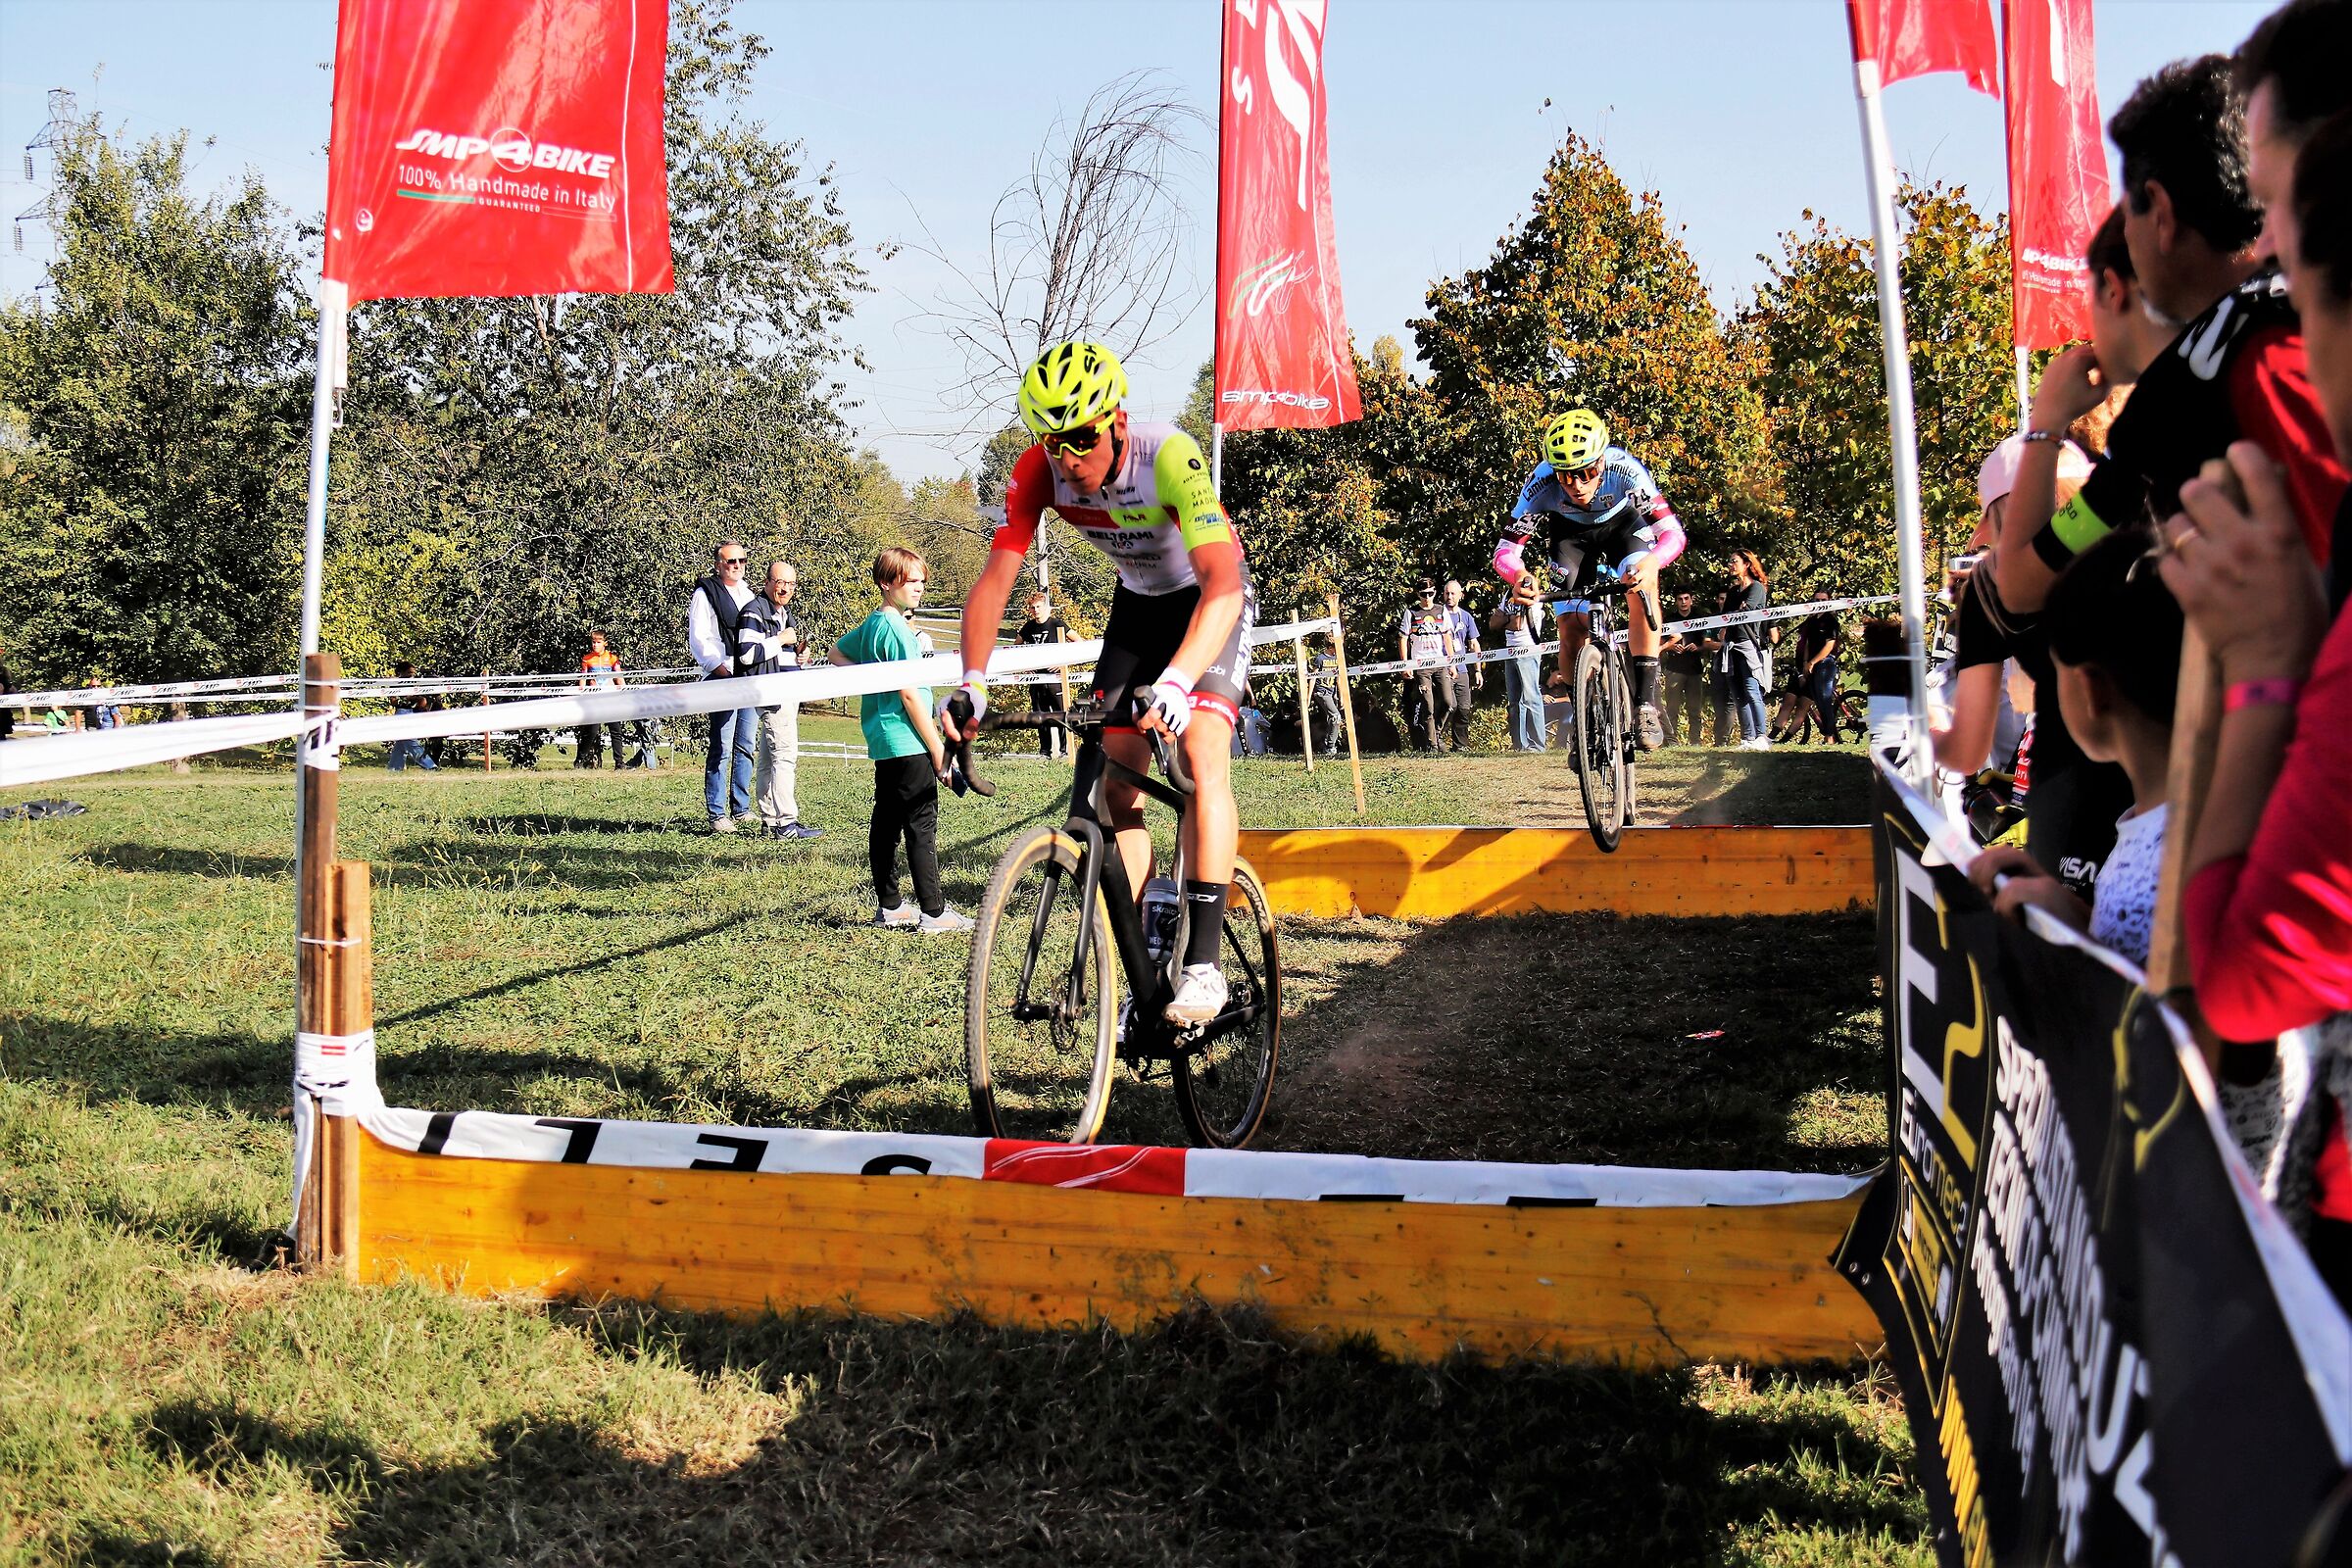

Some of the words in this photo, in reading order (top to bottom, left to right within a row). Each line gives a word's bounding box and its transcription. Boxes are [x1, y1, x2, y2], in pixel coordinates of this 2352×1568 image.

[395, 127, 615, 179] SMP4BIKE
[398, 165, 442, 190] 100%
[450, 172, 549, 202] Handmade
[554, 184, 570, 205] in
[575, 190, 617, 214] Italy
[478, 196, 541, 214] GUARANTEED
[1628, 488, 1650, 509] 24
[1087, 530, 1154, 541] BELTRAMI
[1728, 614, 1748, 624] SMP
[1689, 620, 1709, 630] SMP
[1480, 652, 1496, 662] SMP
[1510, 648, 1529, 658] SMP
[1390, 662, 1407, 671] SMP
